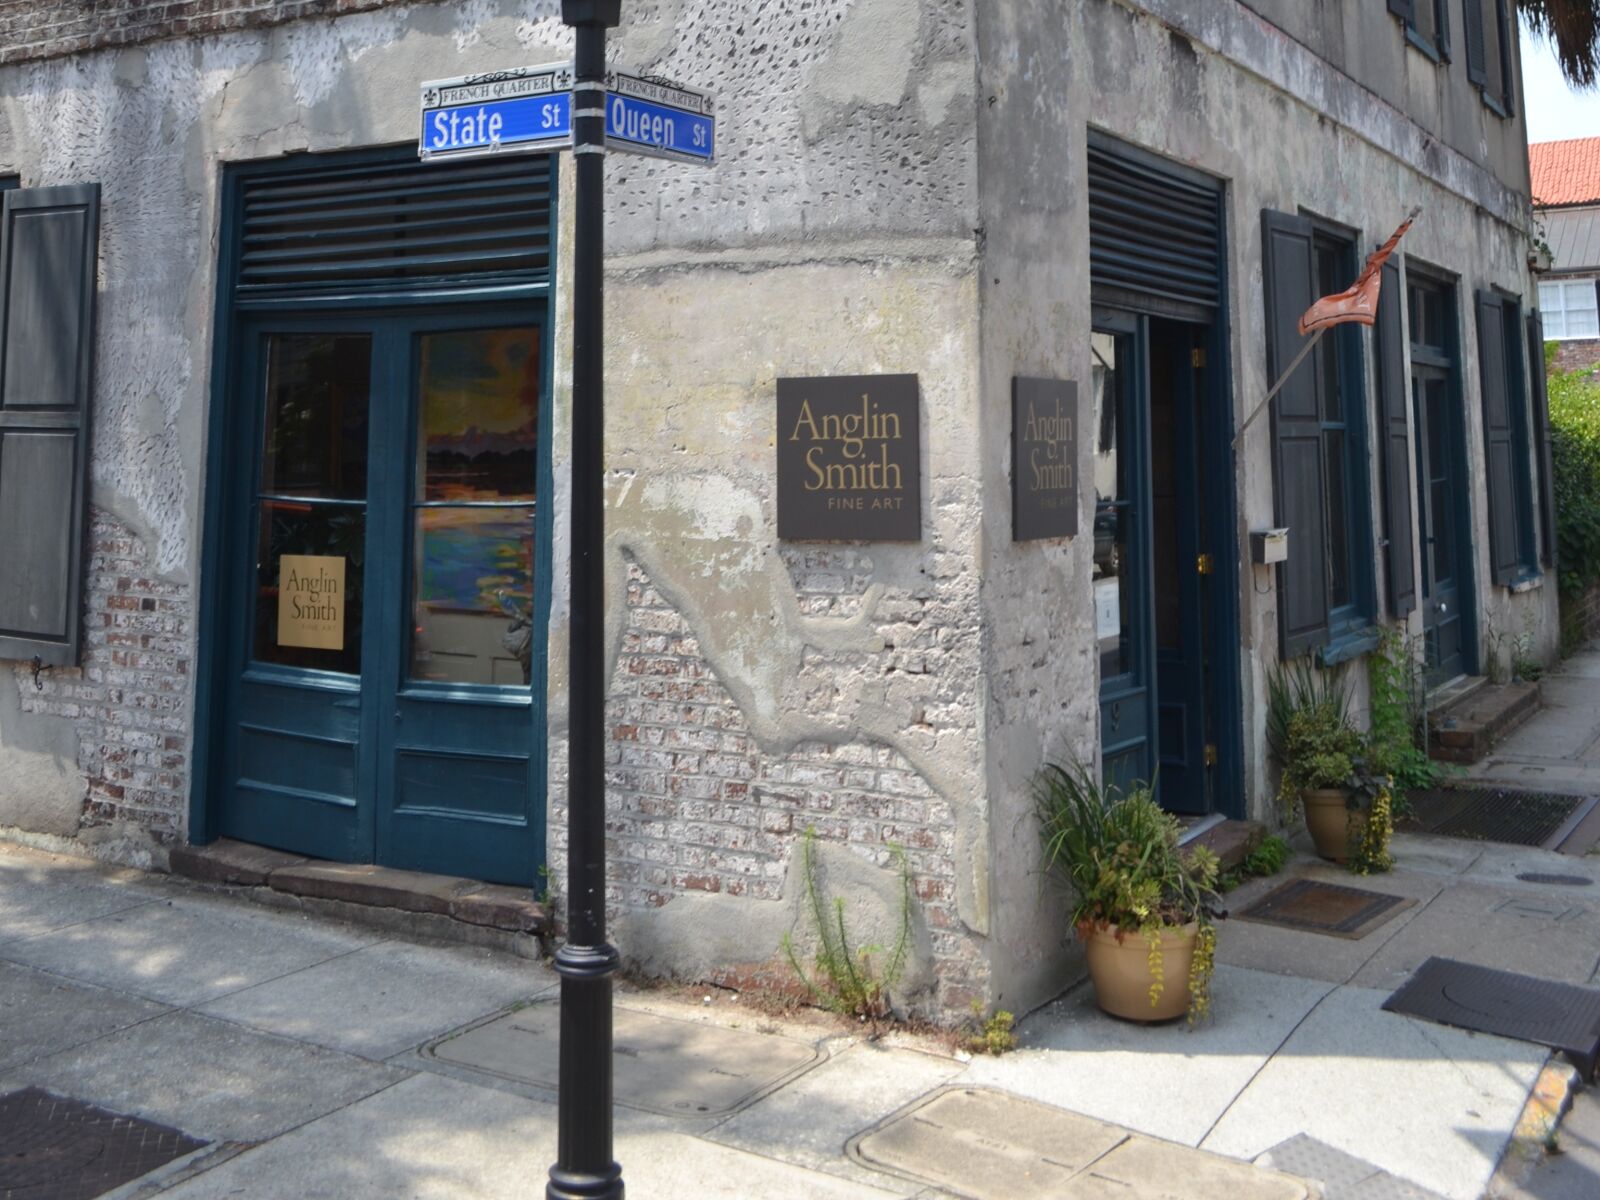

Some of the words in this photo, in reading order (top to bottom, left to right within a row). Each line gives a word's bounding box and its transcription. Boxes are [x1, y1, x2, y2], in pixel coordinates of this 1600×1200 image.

[442, 85, 489, 103] FRENCH
[493, 77, 549, 96] QUARTER
[620, 78, 658, 98] FRENCH
[660, 88, 700, 109] QUARTER
[432, 107, 503, 148] State
[541, 103, 561, 129] St
[612, 97, 675, 147] Queen
[693, 123, 706, 148] St
[789, 393, 903, 458] Anglin
[1023, 398, 1073, 460] Anglin
[804, 444, 903, 491] Smith
[1030, 445, 1073, 492] Smith
[828, 498, 864, 511] FINE
[871, 497, 903, 510] ART
[286, 567, 337, 603] Anglin
[291, 595, 337, 621] Smith
